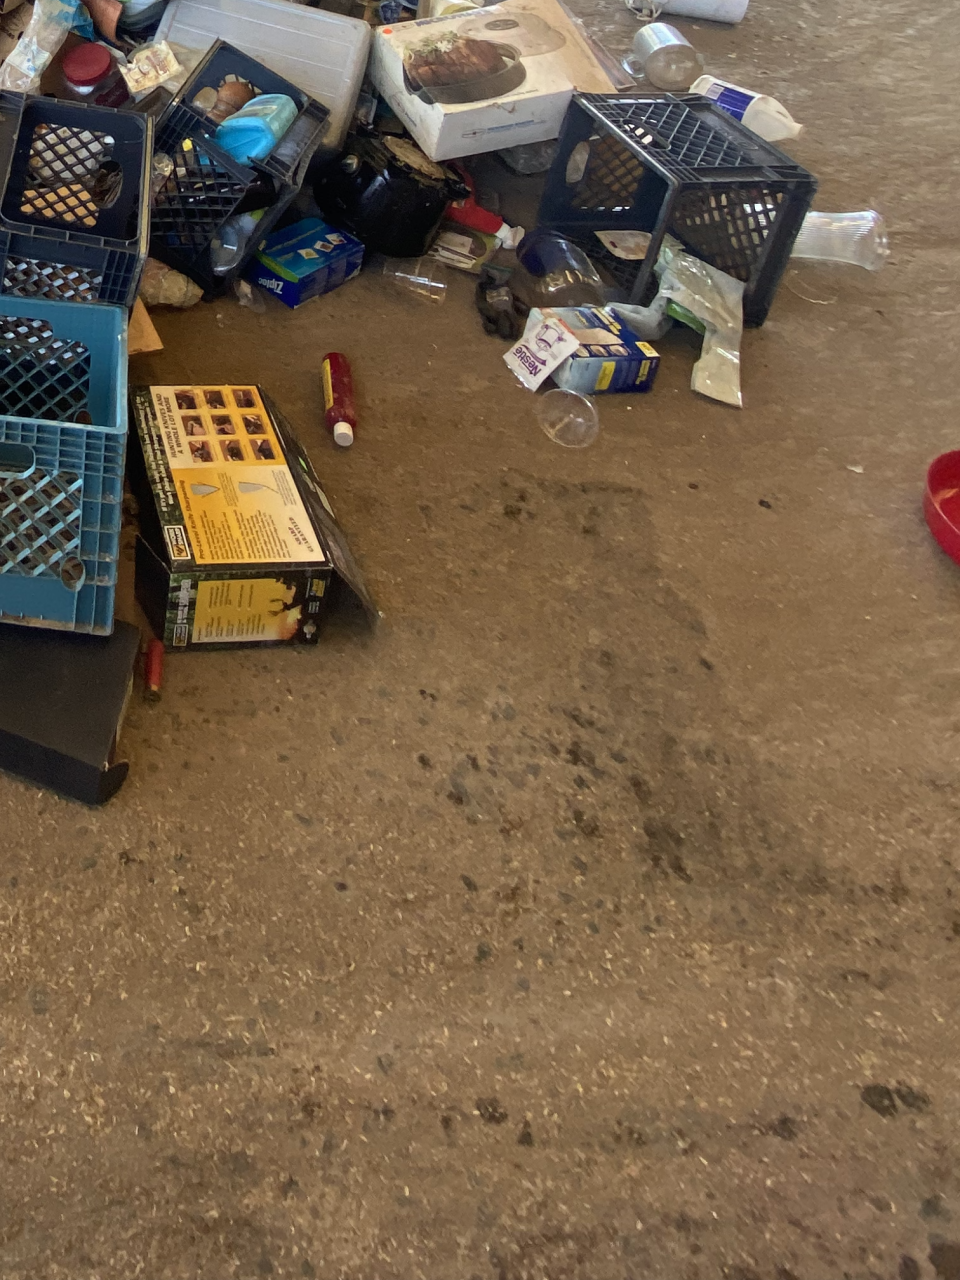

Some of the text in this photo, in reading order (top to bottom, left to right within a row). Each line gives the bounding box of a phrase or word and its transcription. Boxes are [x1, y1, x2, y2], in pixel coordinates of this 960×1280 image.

[258, 276, 284, 294] Ziploc
[164, 396, 172, 410] MORE
[156, 393, 177, 458] HUNTING KNIVES AND
[168, 410, 176, 423] LOT
[171, 423, 183, 448] WHOLE
[180, 480, 190, 512] Sharpening
[193, 530, 205, 560] Pro-Level
[288, 526, 303, 545] SHARP
